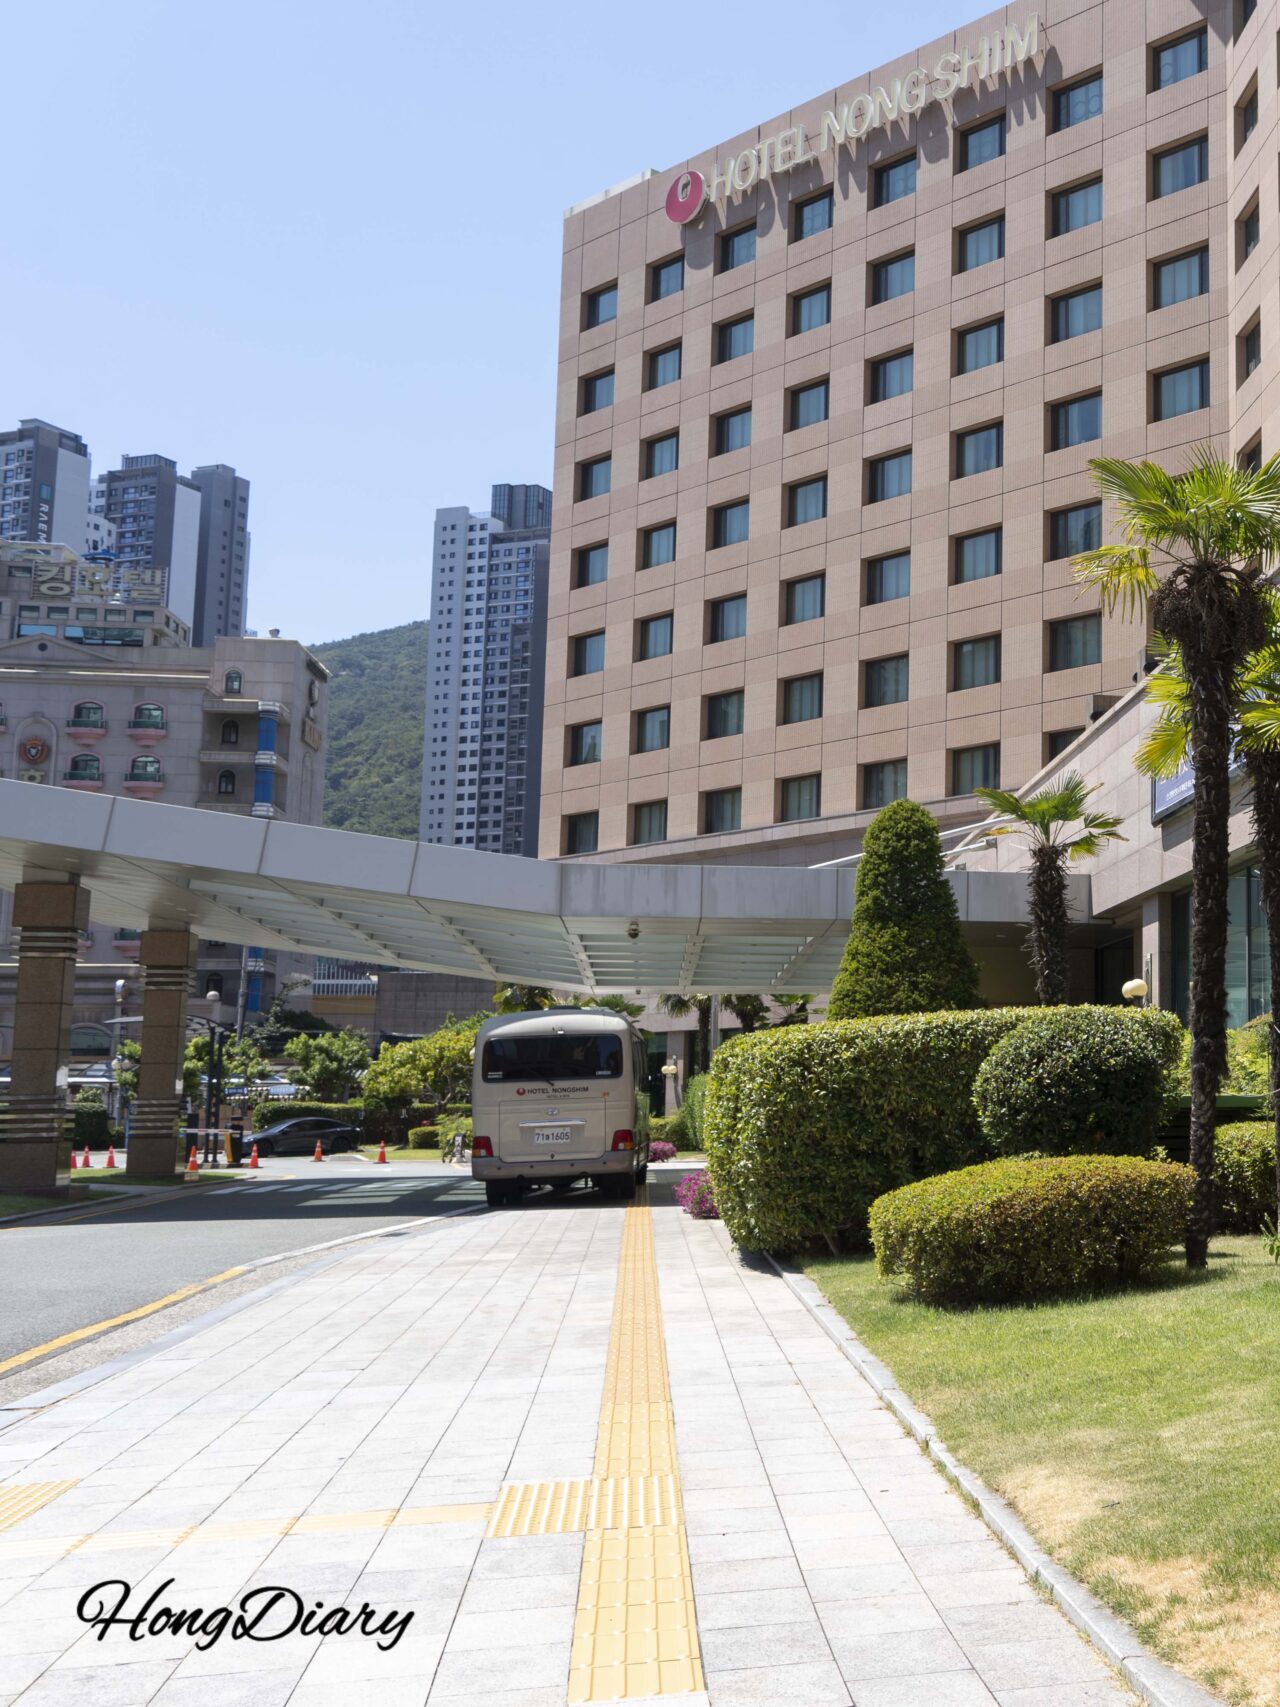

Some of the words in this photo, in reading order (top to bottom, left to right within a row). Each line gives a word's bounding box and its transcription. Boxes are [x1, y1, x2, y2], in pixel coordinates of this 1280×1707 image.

[709, 124, 818, 202] HOTEL
[820, 12, 1041, 152] NONGSHIM
[527, 1087, 549, 1095] HOTEL
[552, 1086, 589, 1094] NONGSHIM
